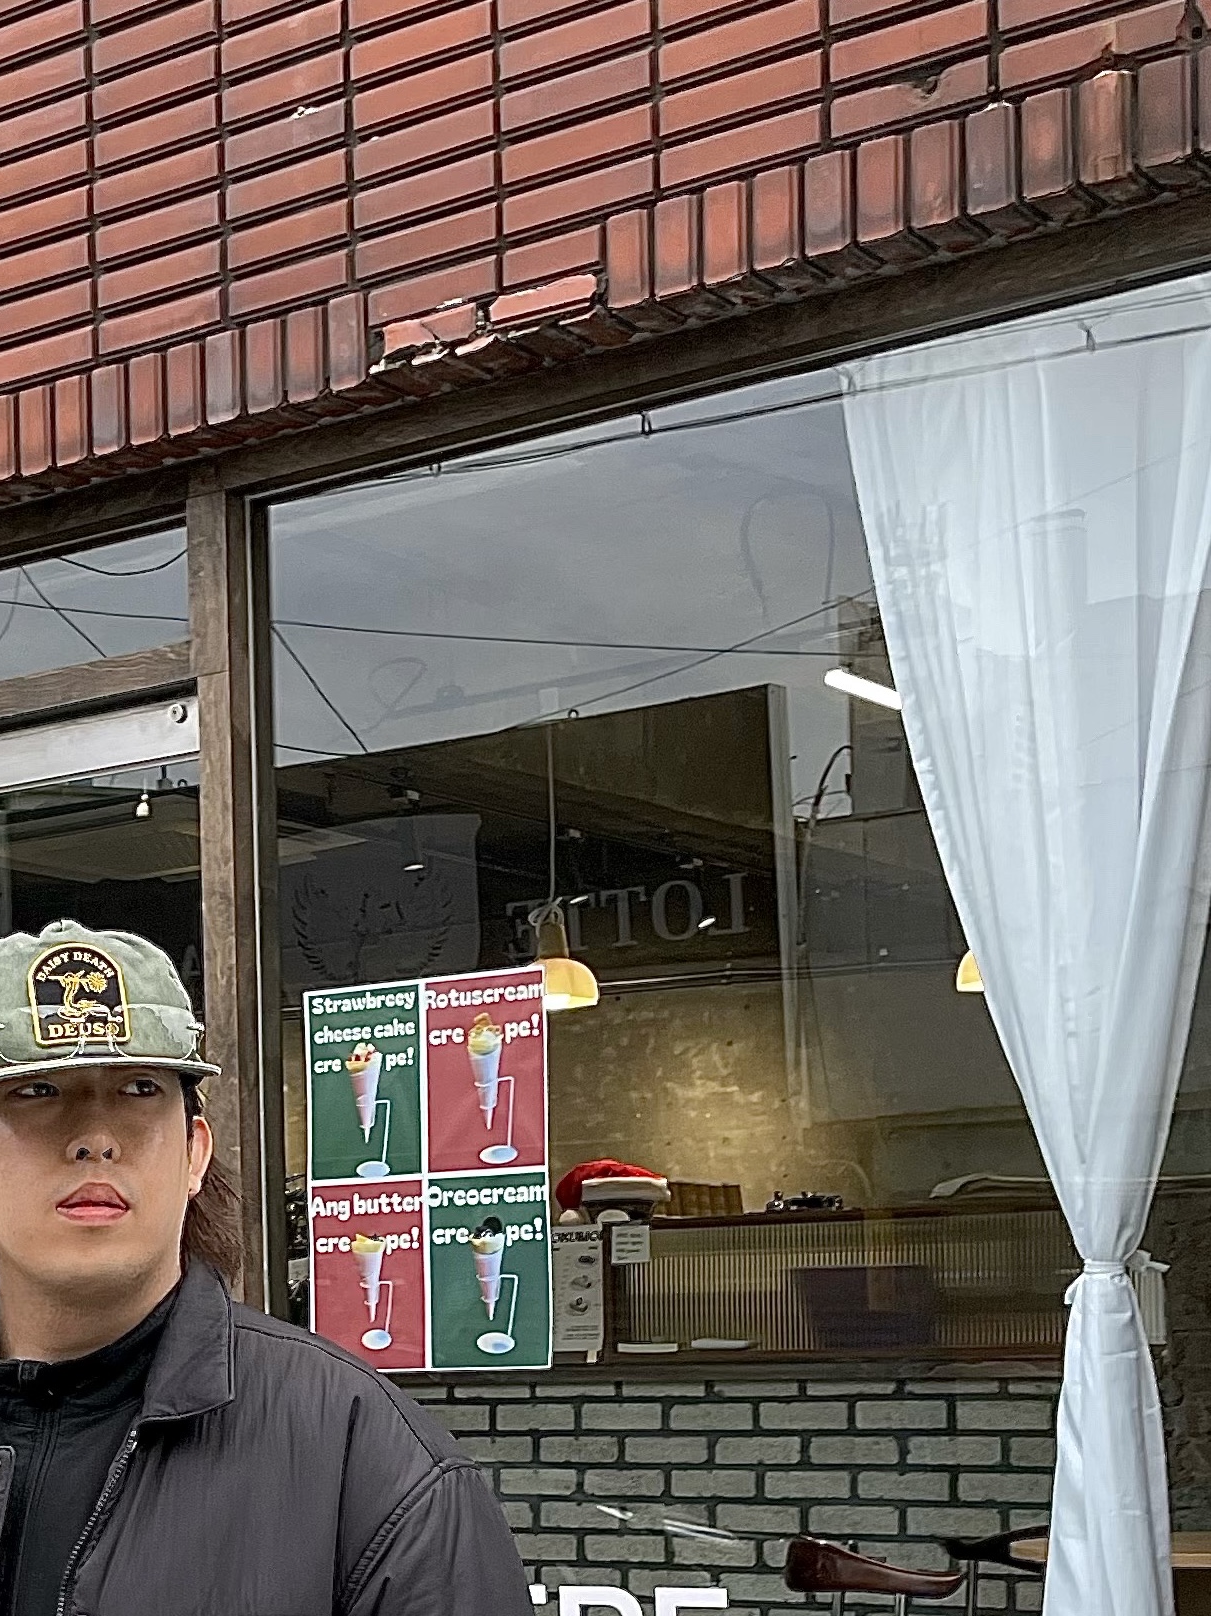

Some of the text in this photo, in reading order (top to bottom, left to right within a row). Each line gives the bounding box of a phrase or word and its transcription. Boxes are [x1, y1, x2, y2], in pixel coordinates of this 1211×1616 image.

[73, 951, 115, 978] DEATH
[314, 1018, 416, 1045] cheese cake
[428, 1013, 540, 1046] cre pe!
[313, 1047, 415, 1074] cre pe!
[311, 1192, 423, 1221] Ang butter
[316, 1226, 420, 1256] cre pe!
[432, 1226, 471, 1246] cre
[506, 1217, 544, 1247] pe!
